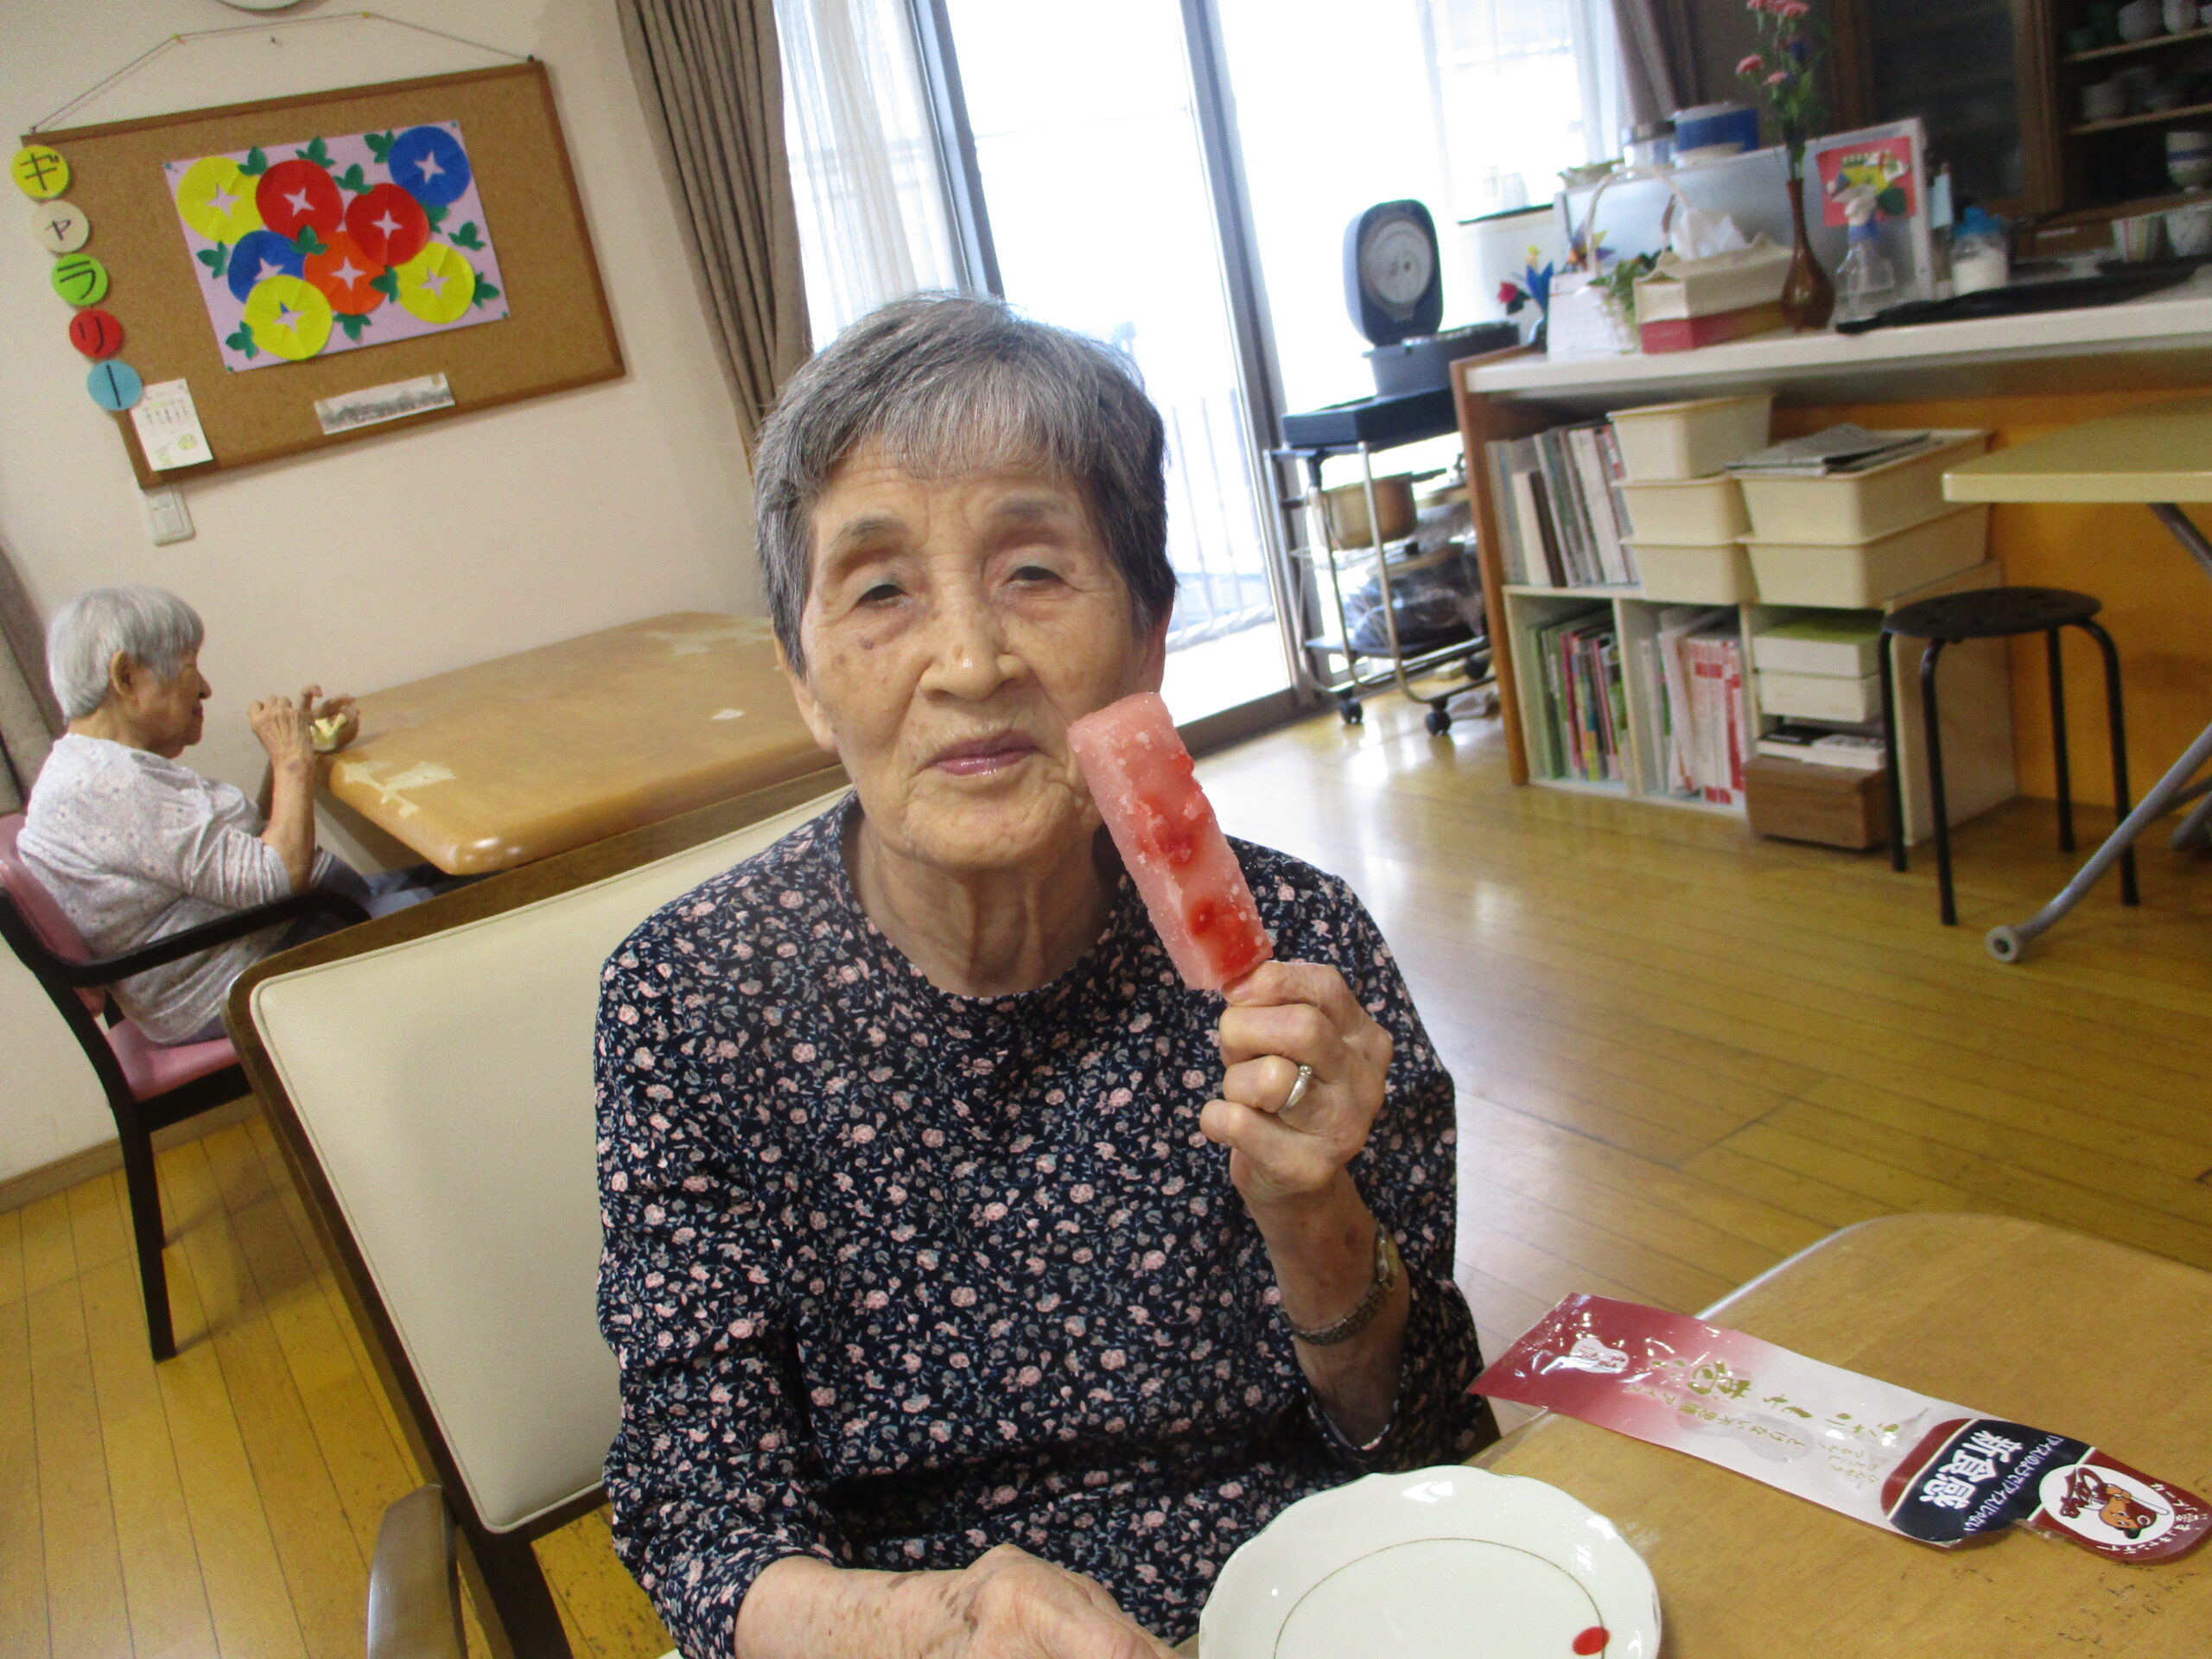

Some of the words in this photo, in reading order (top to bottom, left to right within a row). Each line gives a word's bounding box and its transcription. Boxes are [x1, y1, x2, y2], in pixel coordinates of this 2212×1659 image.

[20, 152, 122, 408] ギャラリー
[1919, 1430, 2024, 1510] 新食感
